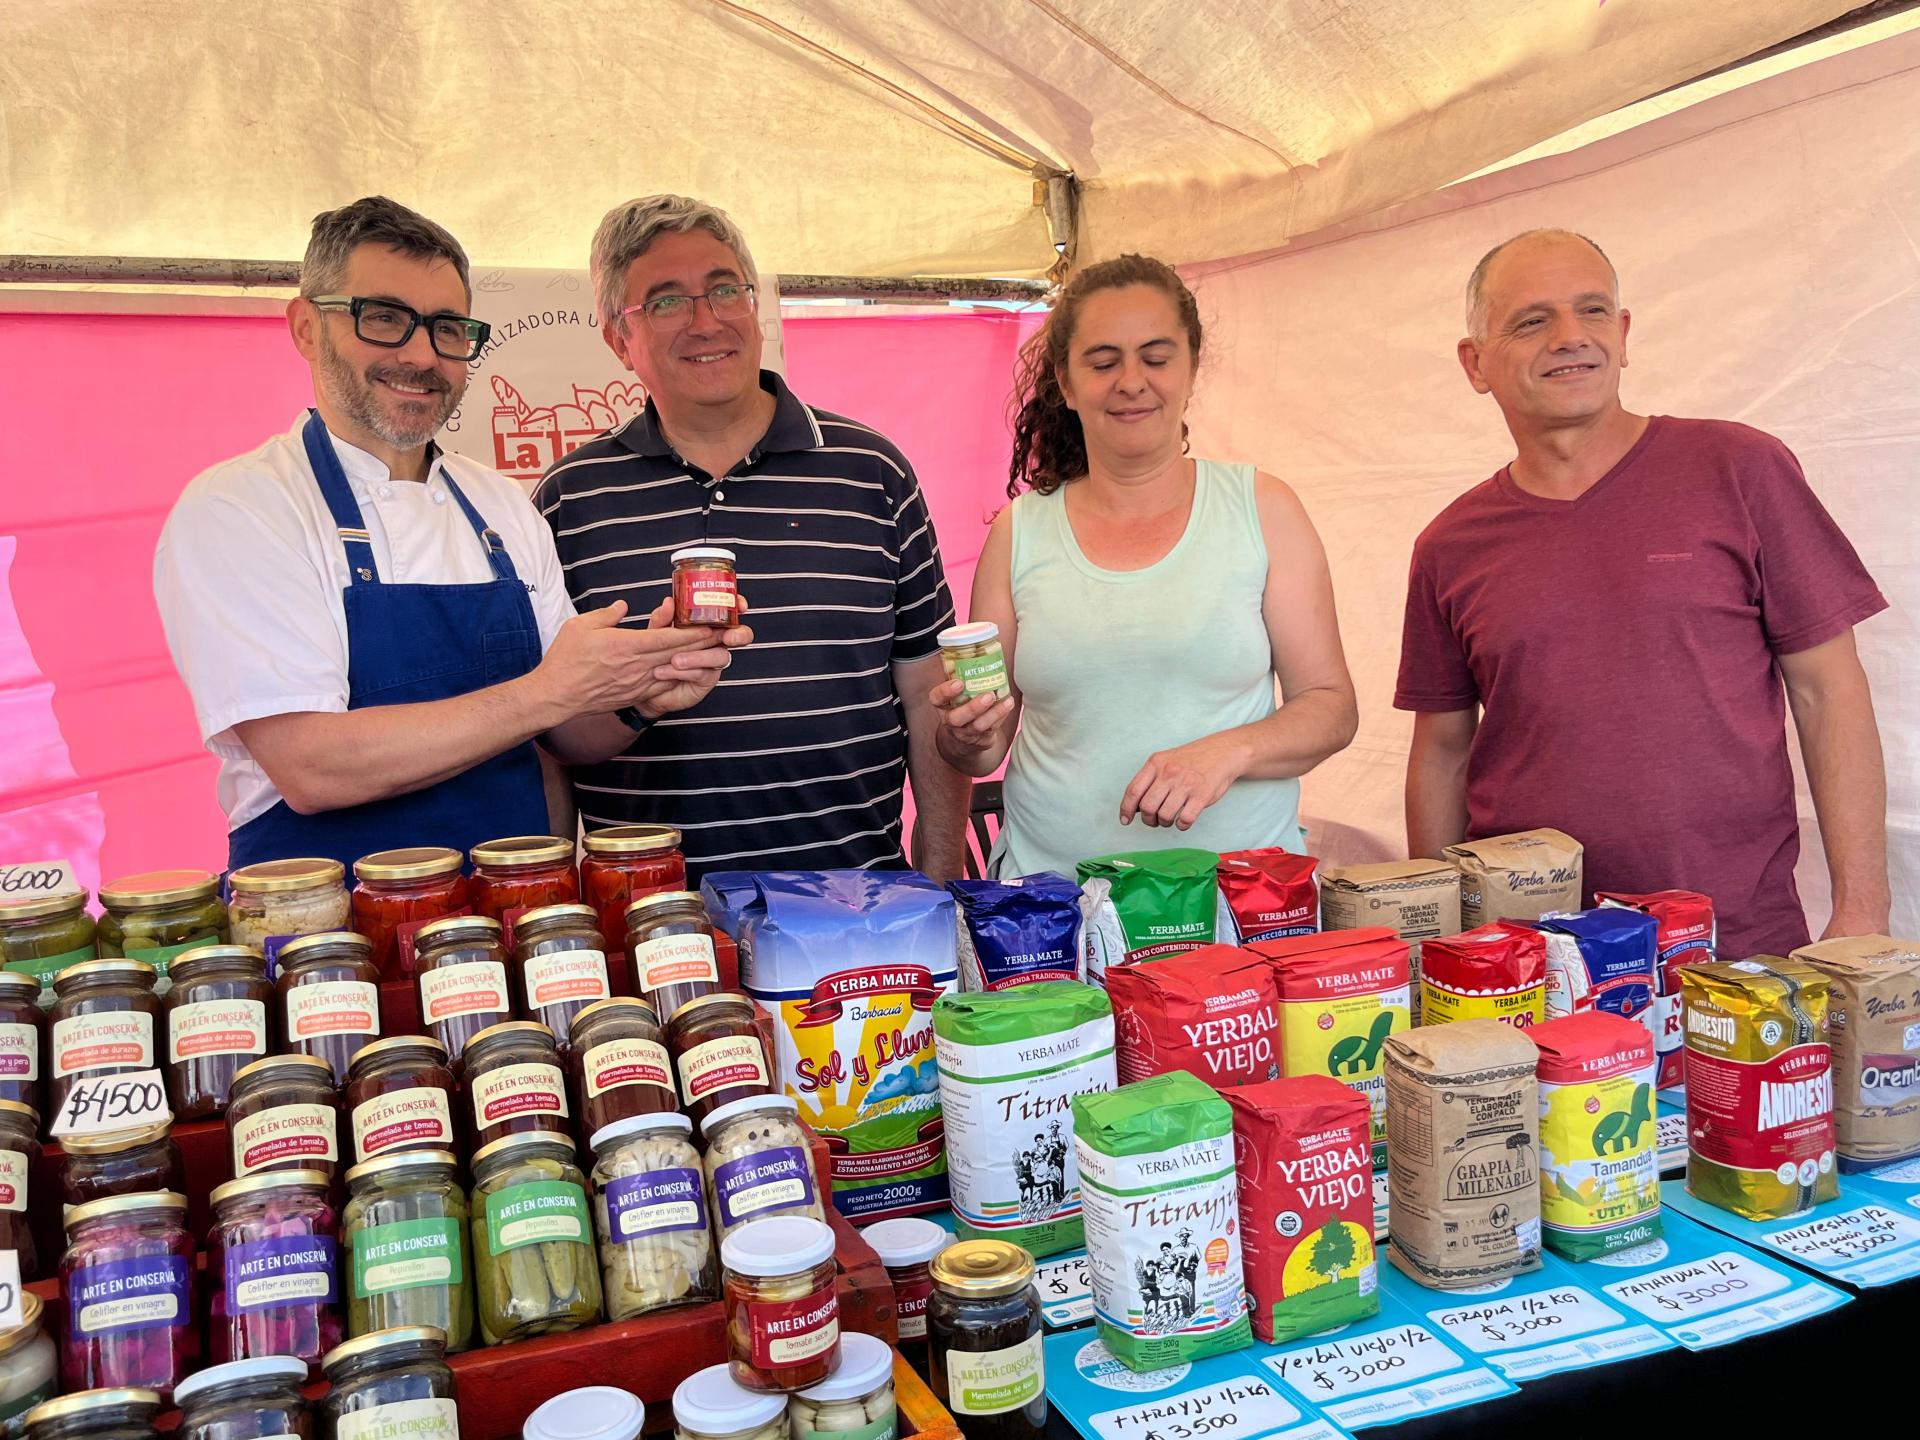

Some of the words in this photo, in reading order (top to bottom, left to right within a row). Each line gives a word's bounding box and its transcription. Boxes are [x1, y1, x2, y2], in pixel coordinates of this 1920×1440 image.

[446, 311, 580, 432] COCIALIZADORA
[492, 433, 541, 469] La
[1507, 870, 1545, 892] Yerba
[1257, 911, 1288, 922] YERBA
[1288, 906, 1309, 918] MATE
[1398, 905, 1420, 914] YERBA
[1421, 902, 1440, 910] MATE
[1401, 910, 1439, 920] ELABORADA
[1148, 925, 1182, 935] YERBA
[1182, 921, 1205, 931] MATE
[1406, 917, 1420, 926] CON
[1420, 915, 1436, 924] PALO
[1667, 927, 1688, 938] YERBA
[1688, 923, 1705, 934] MATE
[1004, 953, 1035, 966] YERBA
[1037, 949, 1063, 961] MATE
[1132, 950, 1150, 961] BAJO
[1150, 943, 1190, 955] CONTENIDO
[1190, 943, 1198, 951] DE
[1605, 963, 1628, 973] YERBA
[1628, 958, 1646, 969] MATE
[830, 976, 879, 994] YERBA
[882, 972, 919, 987] MATE
[995, 976, 1030, 991] MOLIENDA
[1031, 972, 1071, 981] TRADICIONAL
[1315, 973, 1359, 989] YERBA
[1360, 966, 1396, 982] MATE
[1596, 980, 1620, 992] MOLIENDA
[1203, 995, 1232, 1007] YERBA
[1232, 988, 1258, 1000] MATE
[1442, 994, 1460, 1007] MATE
[1494, 996, 1520, 1008] YERBA
[1520, 990, 1537, 1003] MATE
[1866, 994, 1906, 1019] Yerba
[63, 1031, 80, 1045] ARTE
[82, 1028, 95, 1038] EN
[97, 1023, 140, 1035] CONSERVA
[1181, 1005, 1278, 1048] YERBAL
[1687, 1006, 1735, 1045] ANDRESITO
[596, 1053, 615, 1067] ARTE
[617, 1051, 628, 1060] EN
[629, 1048, 662, 1060] CONSERVA
[688, 1057, 707, 1073] ARTE
[708, 1052, 718, 1063] EN
[718, 1047, 753, 1060] CONSERVA
[1017, 1046, 1054, 1062] YERBA
[1056, 1037, 1081, 1054] MATE
[1202, 1037, 1271, 1075] VIEJO
[1581, 1056, 1614, 1073] YERBA
[1614, 1047, 1647, 1064] MATE
[795, 1049, 846, 1092] Sol
[852, 1054, 870, 1086] y
[1779, 1055, 1807, 1075] YERBA
[1809, 1053, 1828, 1065] MATE
[484, 1082, 505, 1097] ARTE
[506, 1079, 517, 1089] EN
[519, 1075, 555, 1086] CONSERVA
[1494, 1089, 1522, 1103] MATE
[68, 1079, 163, 1127] $4500
[995, 1077, 1109, 1122] Titrau
[1469, 1099, 1521, 1115] ELABORADA
[362, 1112, 382, 1128] ARTE
[383, 1107, 395, 1119] EN
[396, 1100, 438, 1114] CONSERVA
[1475, 1110, 1494, 1122] CON
[1494, 1106, 1516, 1118] PALO
[245, 1126, 266, 1142] ARTE
[267, 1121, 280, 1132] EN
[282, 1116, 324, 1129] CONSERVA
[1297, 1135, 1322, 1148] YERBA
[1322, 1127, 1350, 1140] MATE
[1810, 1121, 1828, 1134] ESPECIAL
[247, 1143, 287, 1160] Mermelada
[837, 1159, 854, 1167] YERBA
[872, 1154, 903, 1164] ELABORADA
[904, 1151, 915, 1159] CON
[915, 1146, 929, 1156] PALO
[837, 1161, 901, 1173] ESTACIONAMIENTO
[902, 1151, 931, 1167] NATURAL
[1137, 1158, 1180, 1175] YERBA
[1182, 1148, 1222, 1167] MATE
[1276, 1143, 1370, 1184] YERBAL
[1456, 1159, 1512, 1181] GRAPIA
[725, 1177, 744, 1192] ARTE
[744, 1171, 758, 1182] EN
[758, 1160, 796, 1177] CONSERVA
[1457, 1169, 1532, 1197] MILENARIA
[618, 1191, 639, 1207] ARTE
[641, 1187, 653, 1199] EN
[654, 1181, 692, 1197] CONSERVA
[847, 1196, 864, 1204] PESO
[865, 1193, 883, 1201] NETO
[883, 1184, 922, 1200] 2000g
[1296, 1173, 1365, 1210] VIEJO
[501, 1204, 522, 1220] ARTE
[523, 1200, 536, 1212] EN
[537, 1196, 576, 1209] CONSERVA
[852, 1201, 882, 1211] INDUSTRIA
[883, 1196, 916, 1207] ARGENTINA
[1123, 1184, 1236, 1231] Titrayju
[1596, 1203, 1626, 1220] UTT
[1861, 1207, 1888, 1222] 1/2
[366, 1245, 387, 1262] ARTE
[389, 1241, 402, 1255] EN
[404, 1234, 448, 1252] CONSERVA
[1604, 1240, 1622, 1249] NETO
[1605, 1233, 1622, 1243] PESO
[240, 1259, 265, 1277] ARTE
[268, 1255, 281, 1270] EN
[284, 1249, 327, 1267] CONSERVA
[84, 1282, 107, 1300] ARTE
[110, 1278, 123, 1293] EN
[126, 1270, 175, 1289] CONSERVA
[247, 1279, 278, 1293] Coliflor
[292, 1275, 319, 1288] vinagre
[1618, 1266, 1705, 1298] TAMANDUA
[1709, 1259, 1740, 1278] 1/2
[767, 1321, 791, 1334] ARTE
[793, 1317, 806, 1329] EN
[807, 1296, 838, 1323] CONSERVA
[1441, 1305, 1513, 1326] GRAPIA
[1521, 1299, 1549, 1316] 1/2
[1551, 1292, 1580, 1306] KG
[1399, 1328, 1433, 1349] 1/2
